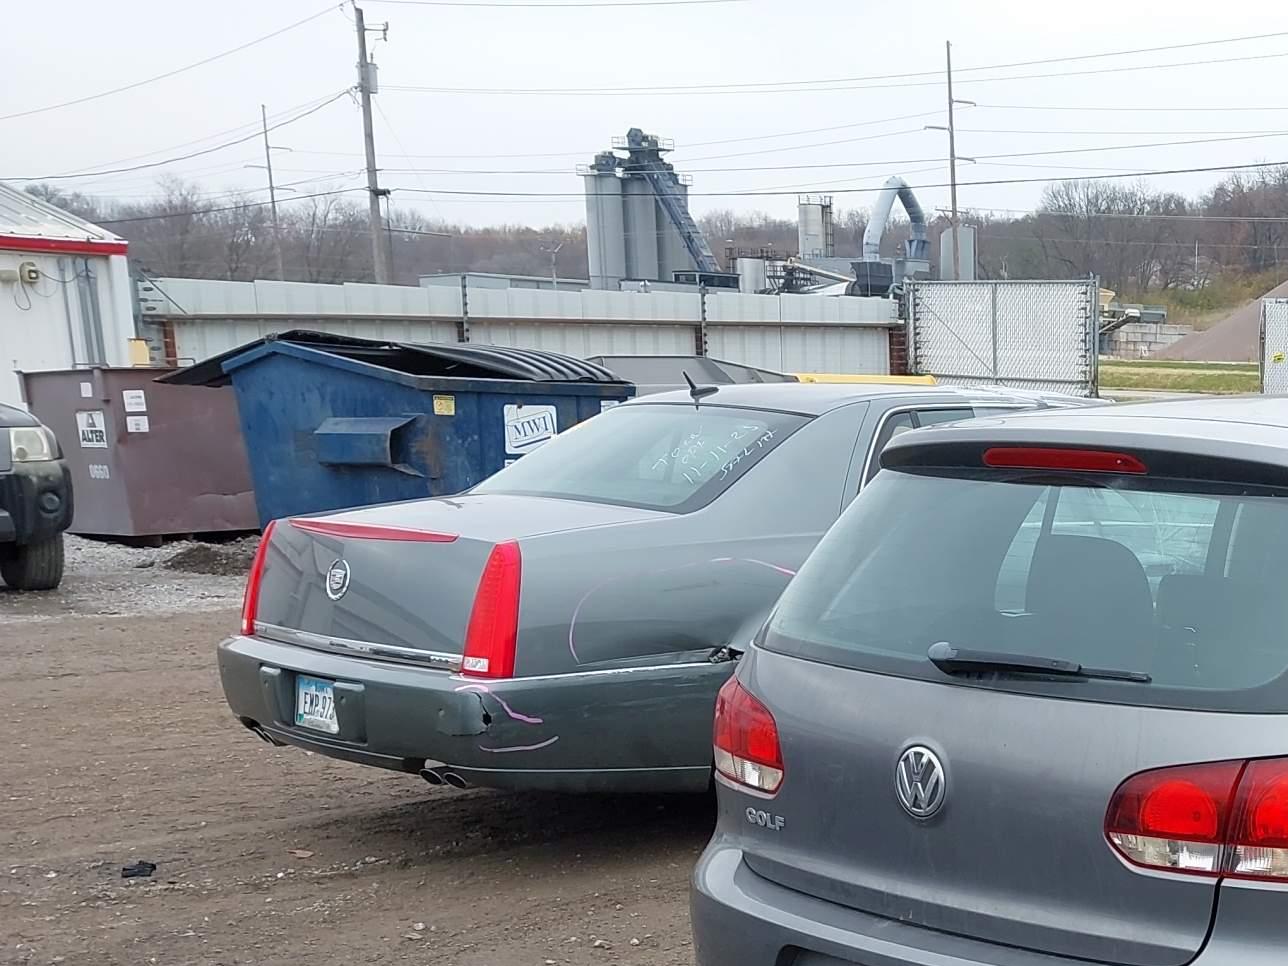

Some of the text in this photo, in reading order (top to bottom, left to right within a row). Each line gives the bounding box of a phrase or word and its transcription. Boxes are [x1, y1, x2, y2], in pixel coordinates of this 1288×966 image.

[81, 429, 105, 443] ALTER
[512, 415, 550, 440] MWI
[746, 807, 785, 831] GOLF
